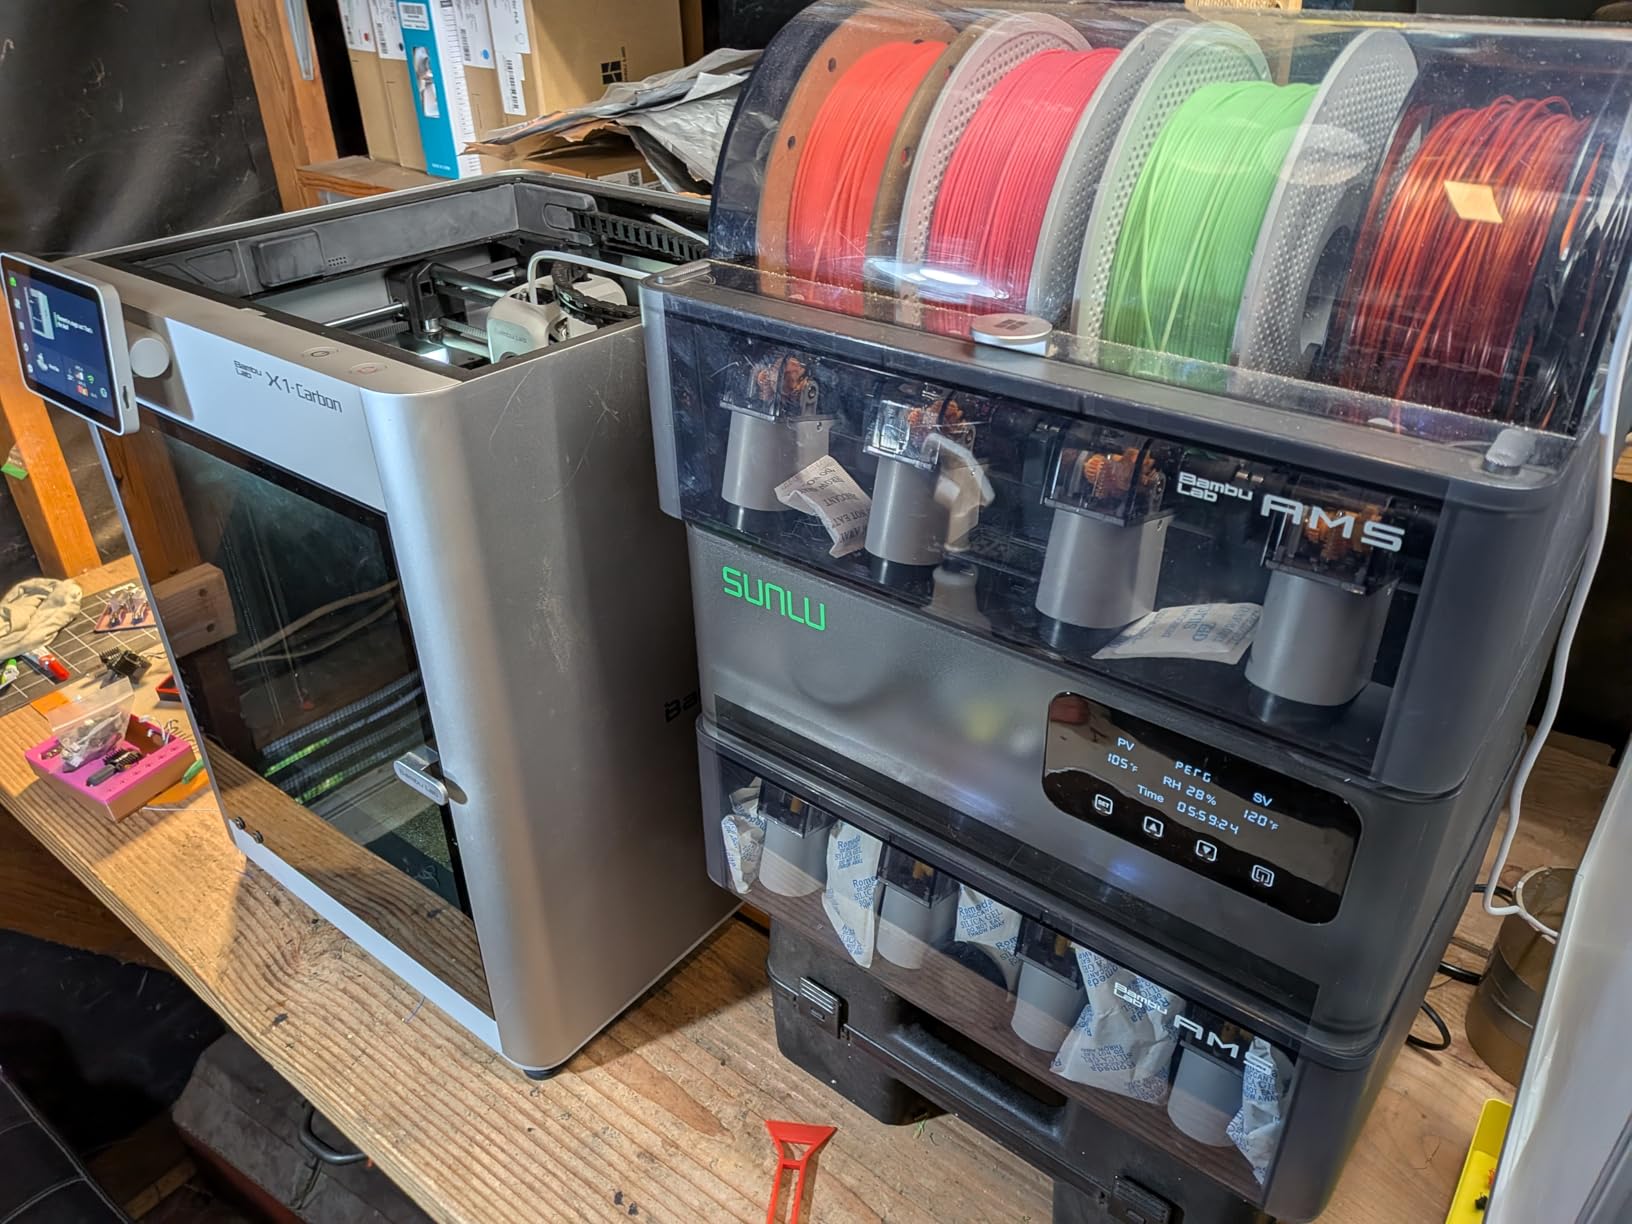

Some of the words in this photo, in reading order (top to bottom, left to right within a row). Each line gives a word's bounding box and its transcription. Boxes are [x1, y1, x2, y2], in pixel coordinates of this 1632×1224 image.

[233, 360, 263, 376] Bambu
[265, 371, 343, 413] X1-Carbon
[1176, 482, 1219, 503] Lab
[1178, 471, 1254, 501] Bambu
[1260, 494, 1405, 552] AMS
[1117, 736, 1135, 752] PV
[1137, 784, 1165, 803] Time
[1163, 776, 1182, 791] RH
[1186, 785, 1217, 806] 28%
[1252, 792, 1273, 807] SV
[1113, 989, 1143, 1008] Lab
[1114, 982, 1168, 1015] Bambu
[1173, 1014, 1274, 1076] AMS
